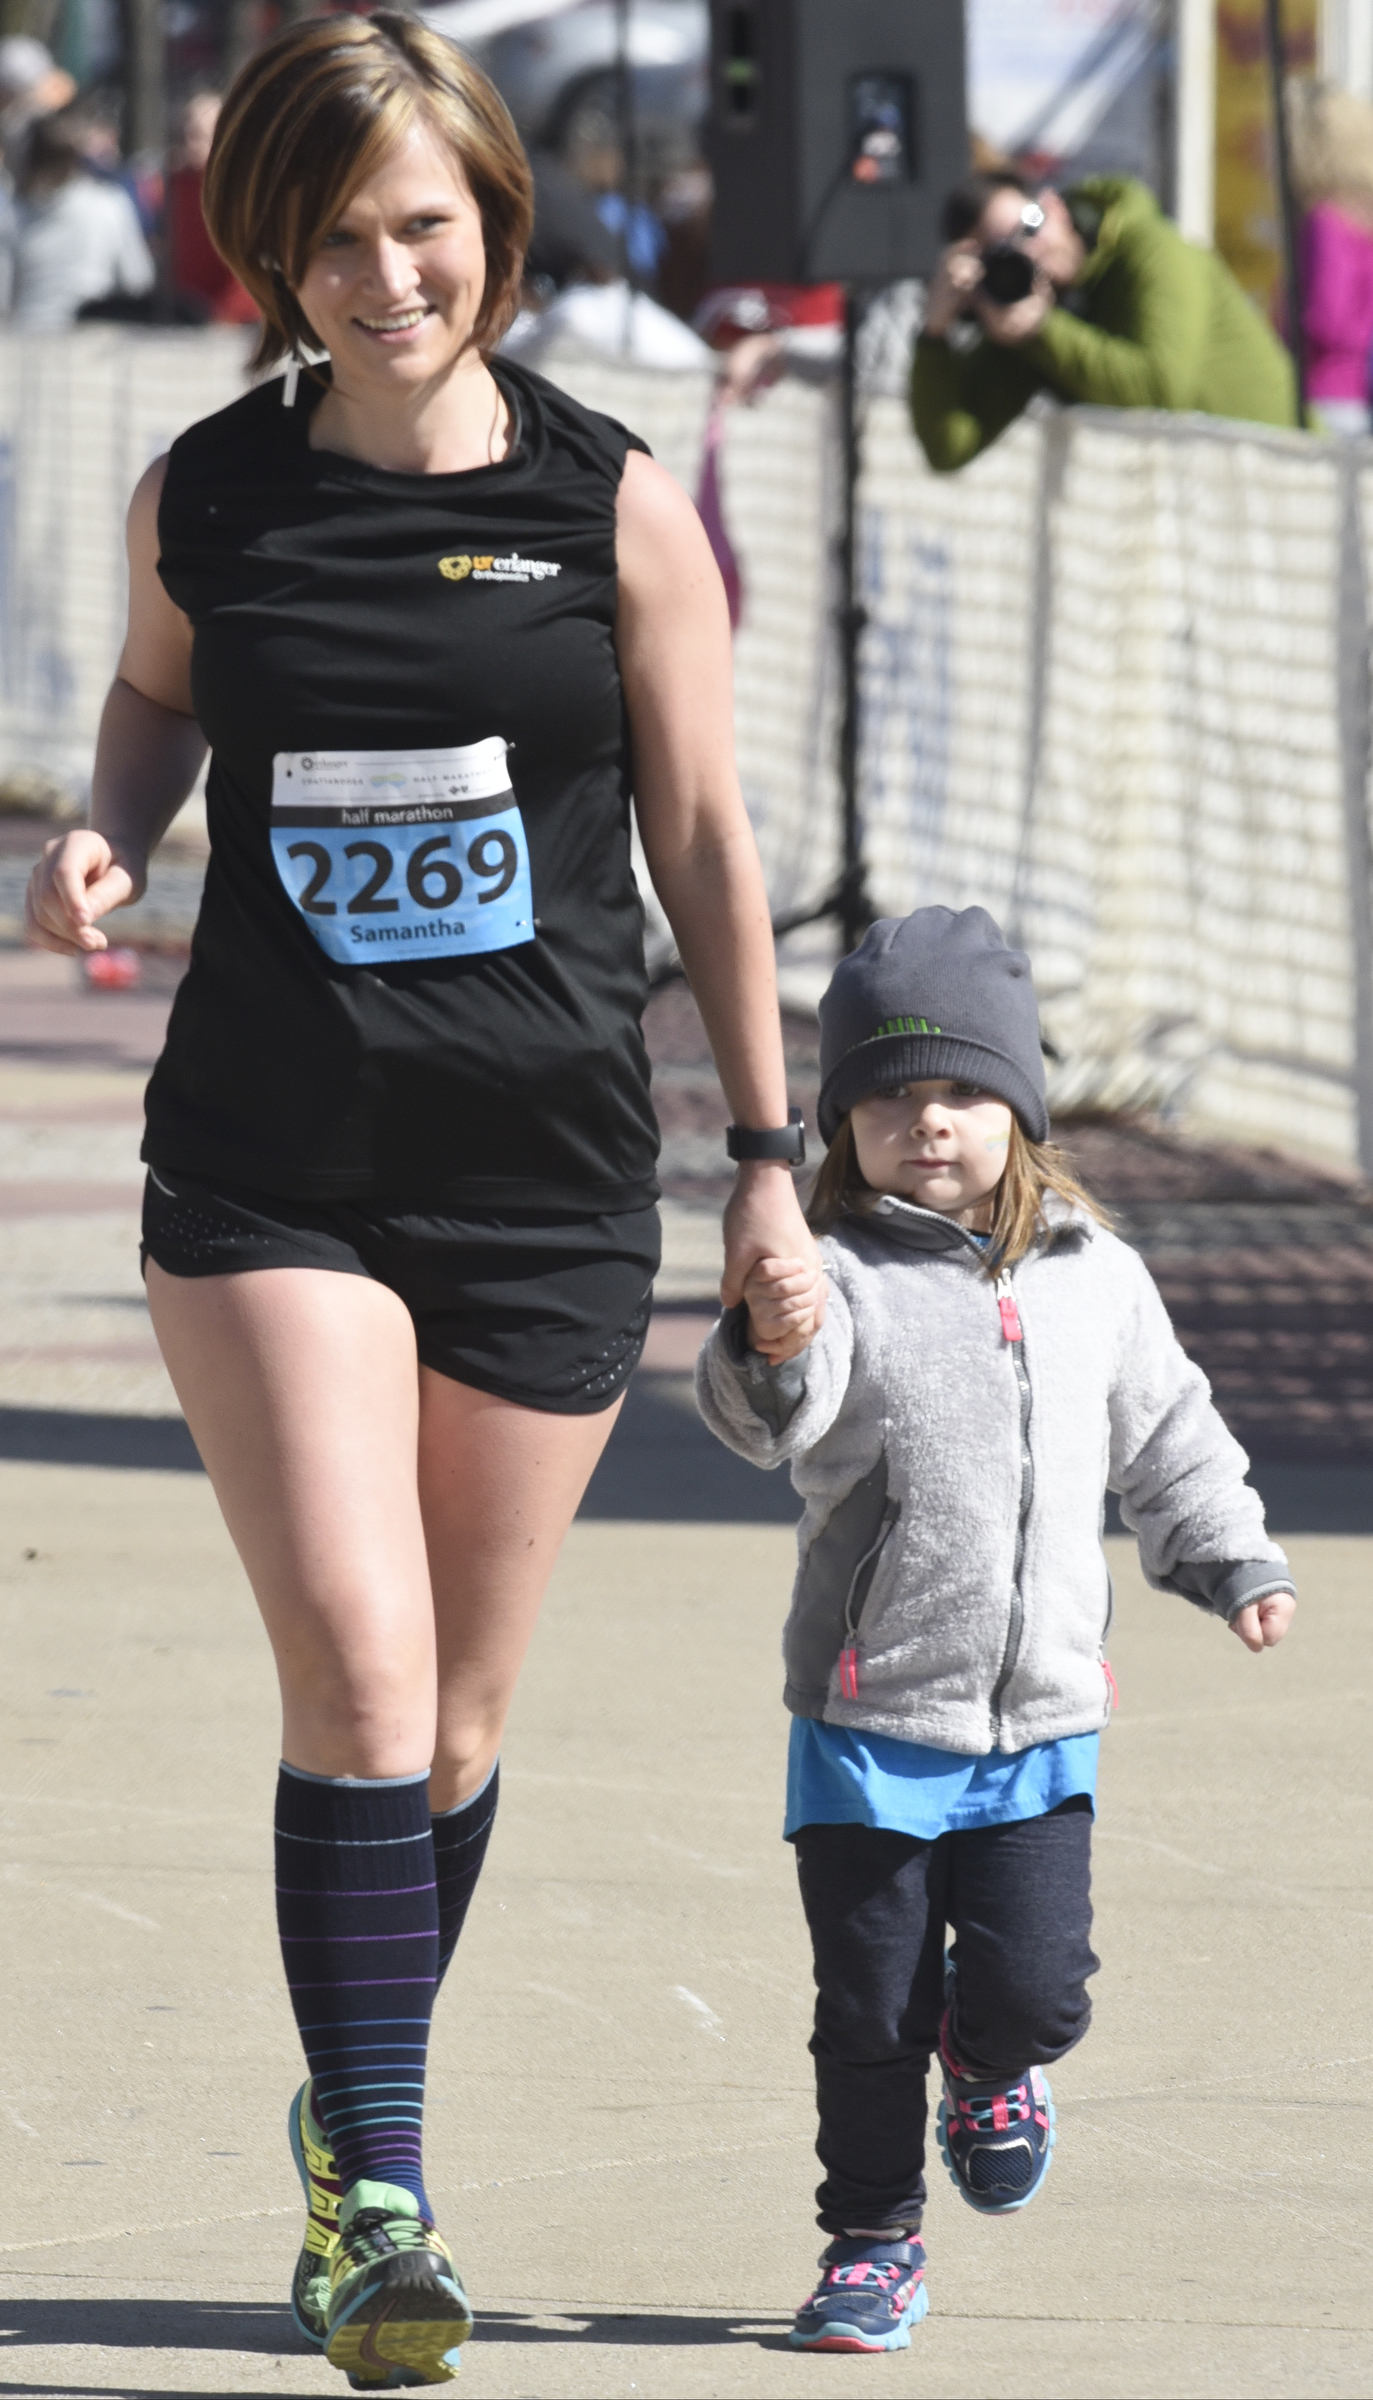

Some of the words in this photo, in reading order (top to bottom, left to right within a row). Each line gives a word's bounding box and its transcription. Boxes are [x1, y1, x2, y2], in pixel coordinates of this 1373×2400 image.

[492, 552, 561, 581] erlanger
[341, 808, 370, 825] half
[374, 805, 453, 824] marathon
[286, 829, 518, 915] 2269
[350, 917, 466, 943] Samantha
